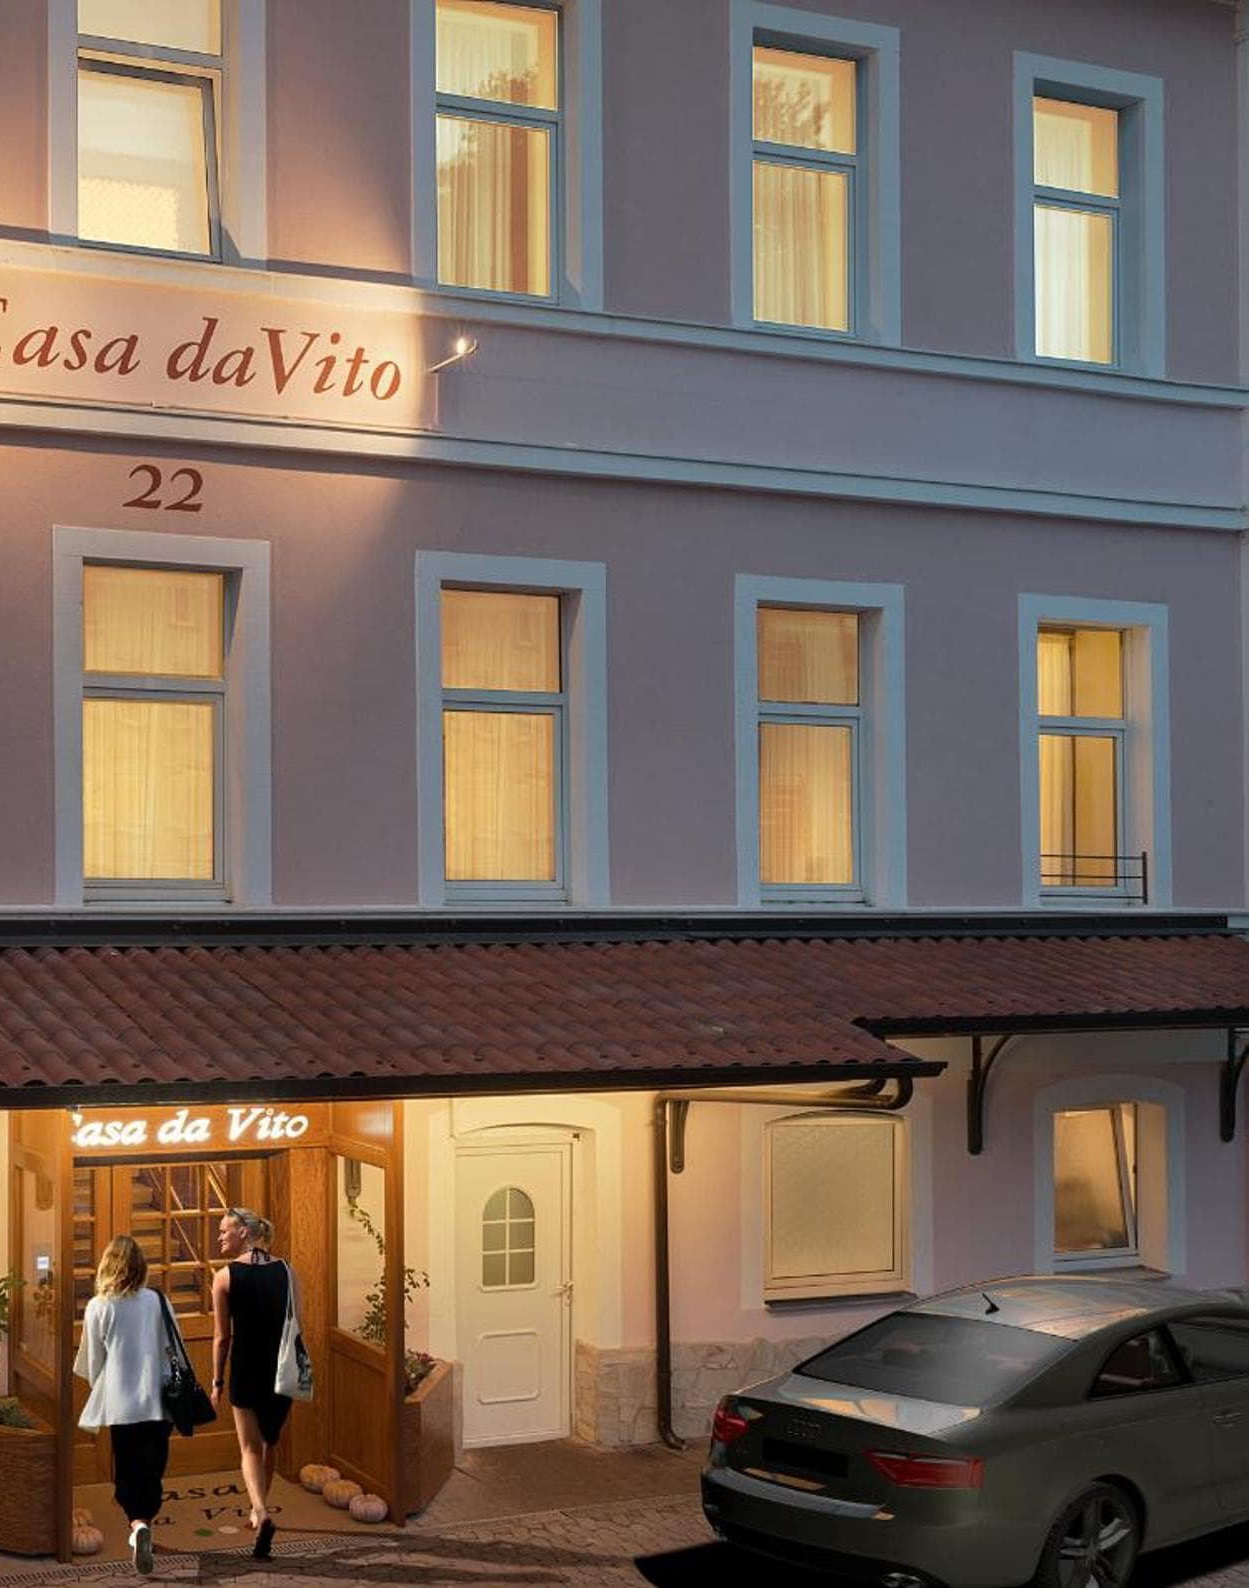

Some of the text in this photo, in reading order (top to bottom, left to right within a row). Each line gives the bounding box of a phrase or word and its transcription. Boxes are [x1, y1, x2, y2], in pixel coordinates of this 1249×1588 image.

[122, 464, 204, 513] 22
[72, 1107, 309, 1147] asa da Vito
[162, 1484, 248, 1502] asa
